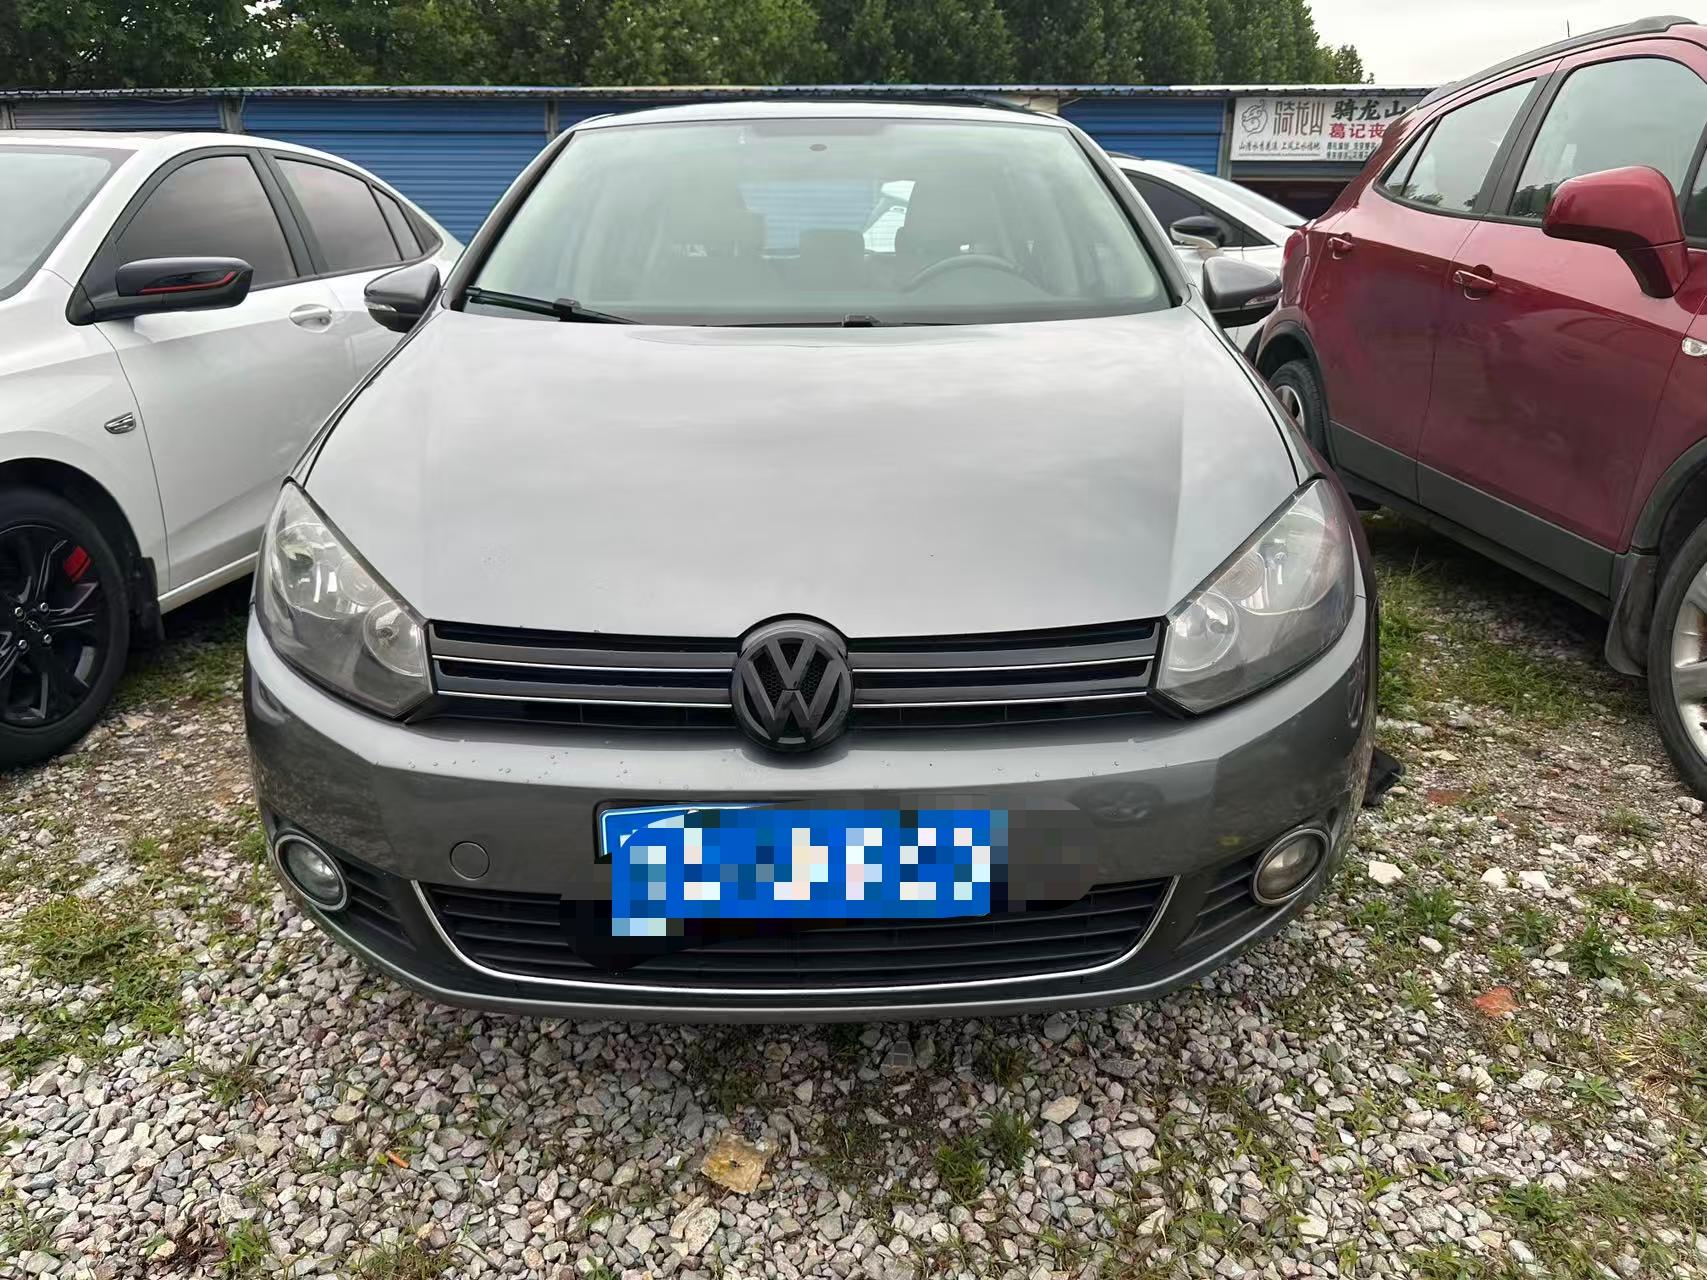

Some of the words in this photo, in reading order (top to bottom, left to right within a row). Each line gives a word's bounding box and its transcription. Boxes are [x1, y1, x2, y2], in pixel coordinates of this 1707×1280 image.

[1273, 101, 1325, 136] 骑龙山
[1331, 99, 1407, 122] 骑龙山
[738, 630, 845, 745] VW
